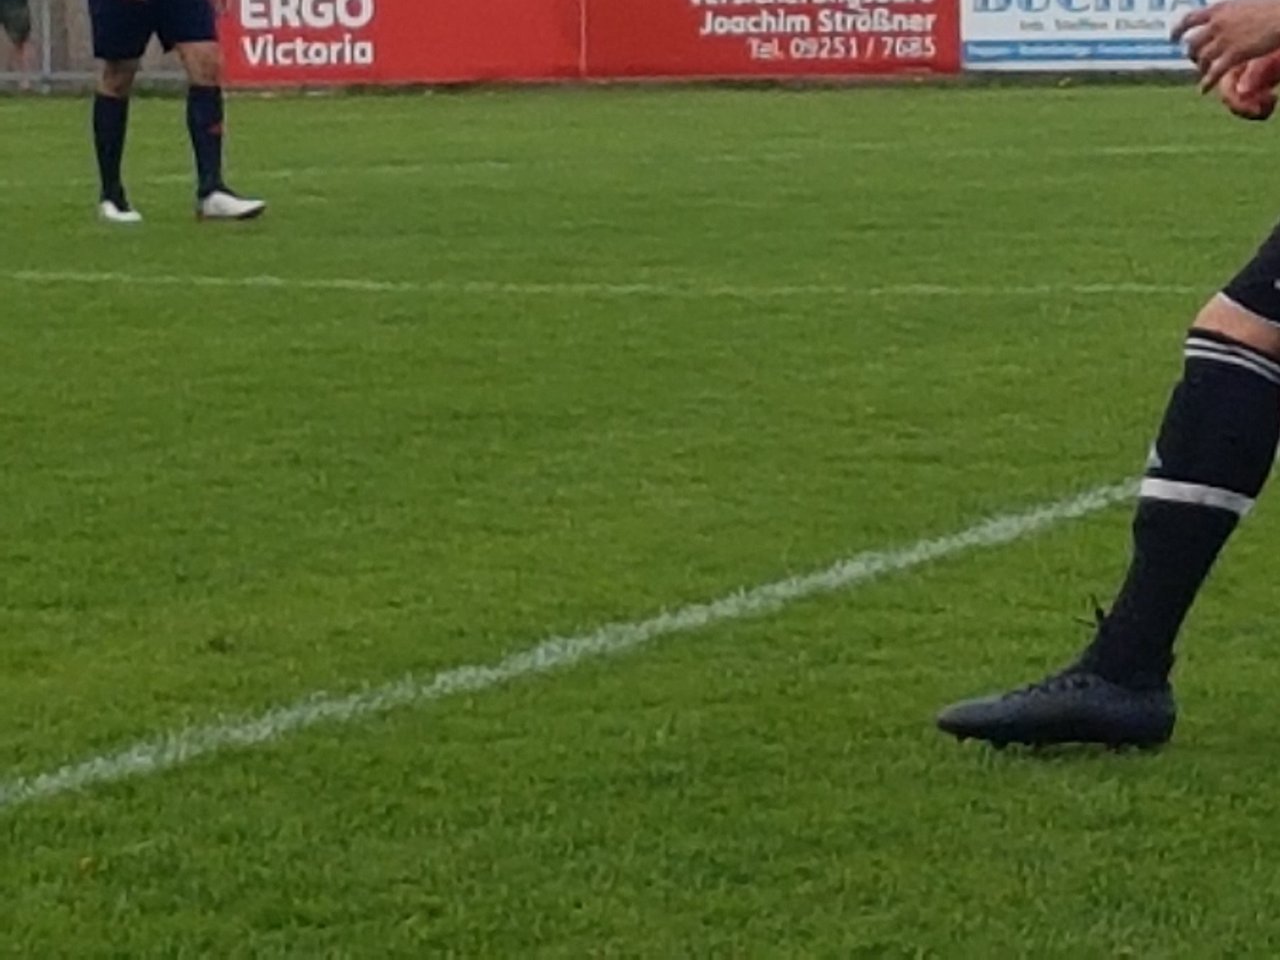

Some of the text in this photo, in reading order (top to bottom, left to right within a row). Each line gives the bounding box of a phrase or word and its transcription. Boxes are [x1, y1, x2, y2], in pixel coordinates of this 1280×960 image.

[700, 8, 936, 34] Joachim Strößner
[242, 34, 374, 66] Victoria
[748, 38, 783, 59] Tel.
